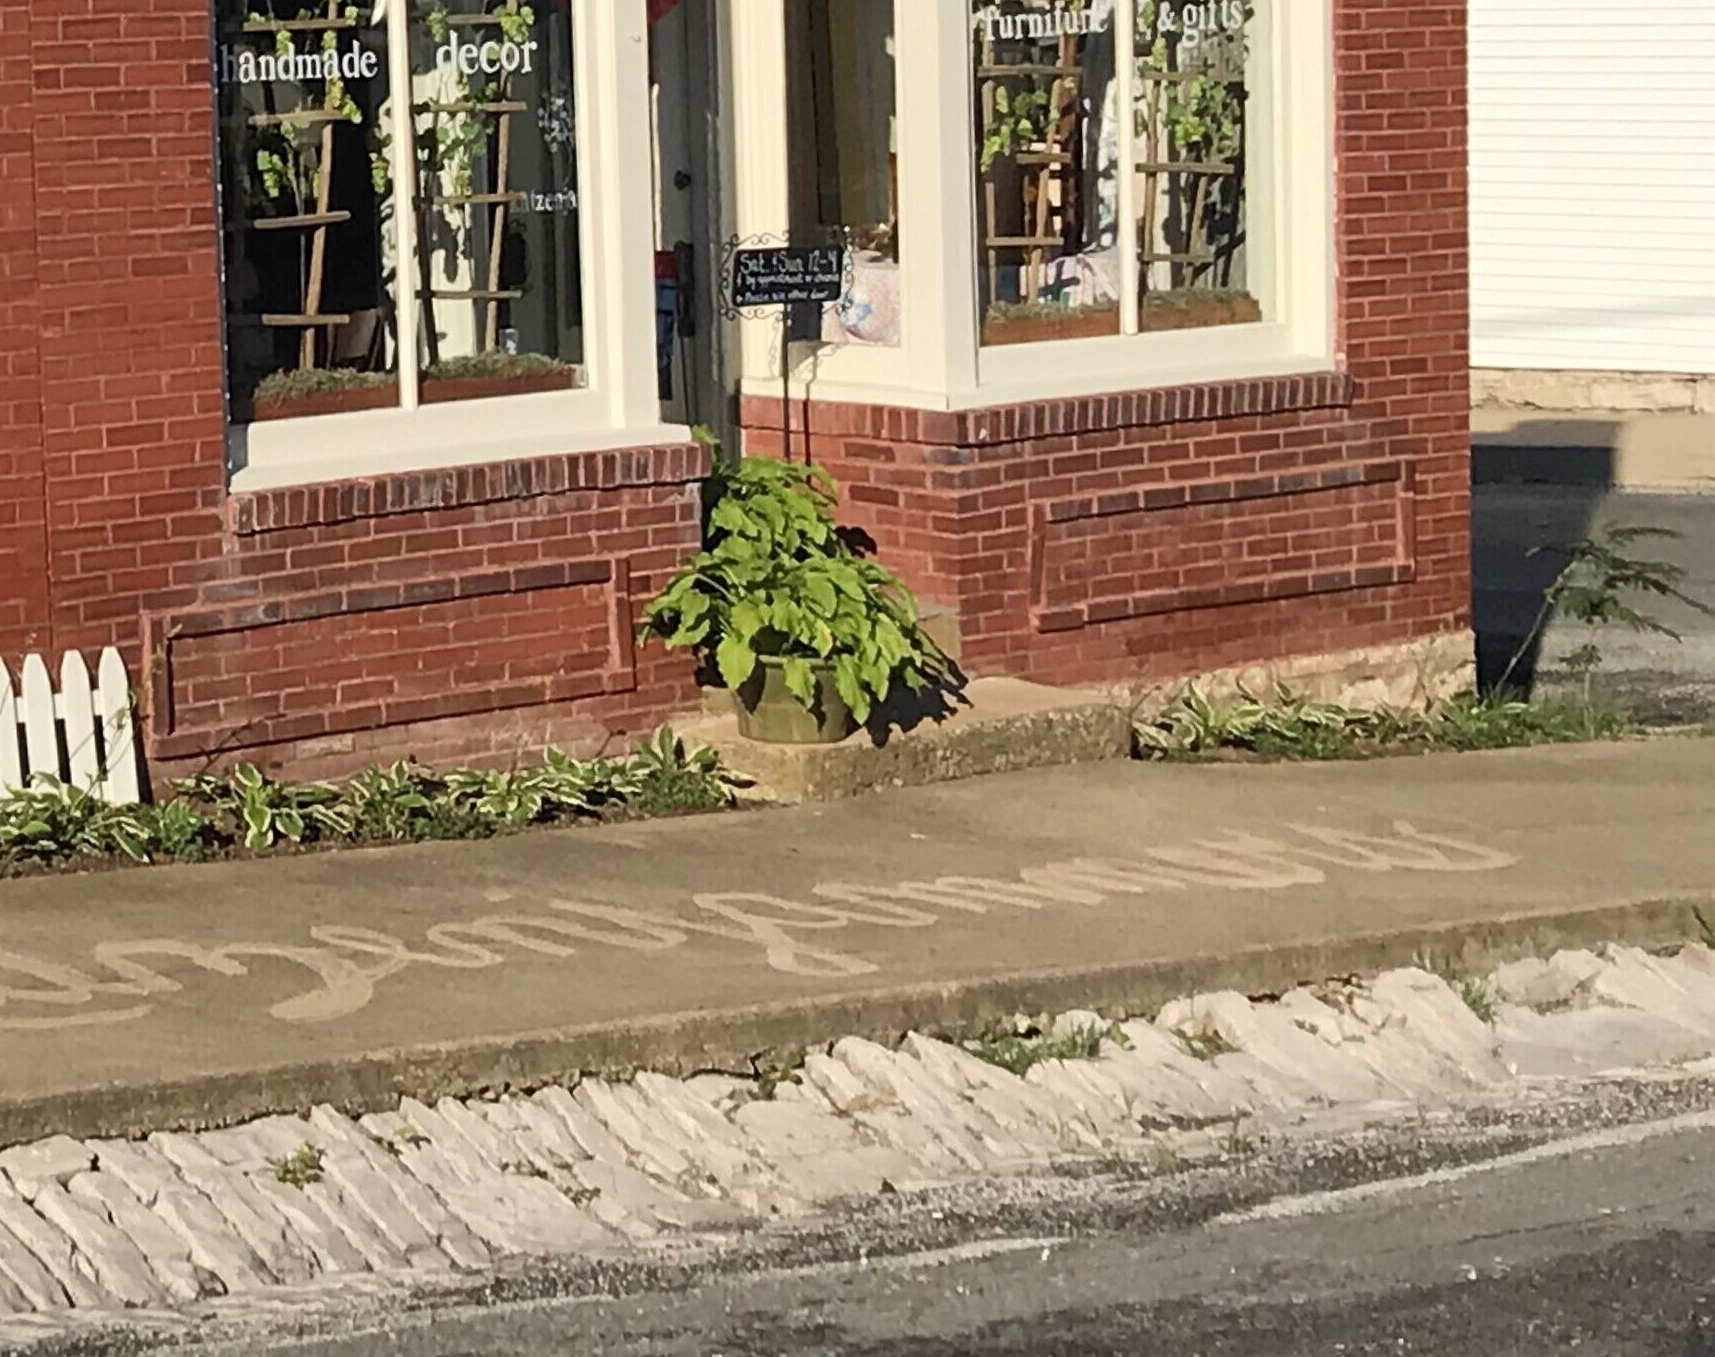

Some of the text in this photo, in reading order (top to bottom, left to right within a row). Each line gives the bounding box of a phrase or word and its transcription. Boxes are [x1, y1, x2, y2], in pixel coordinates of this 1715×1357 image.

[1157, 1, 1176, 32] &
[220, 30, 538, 83] handmade decor
